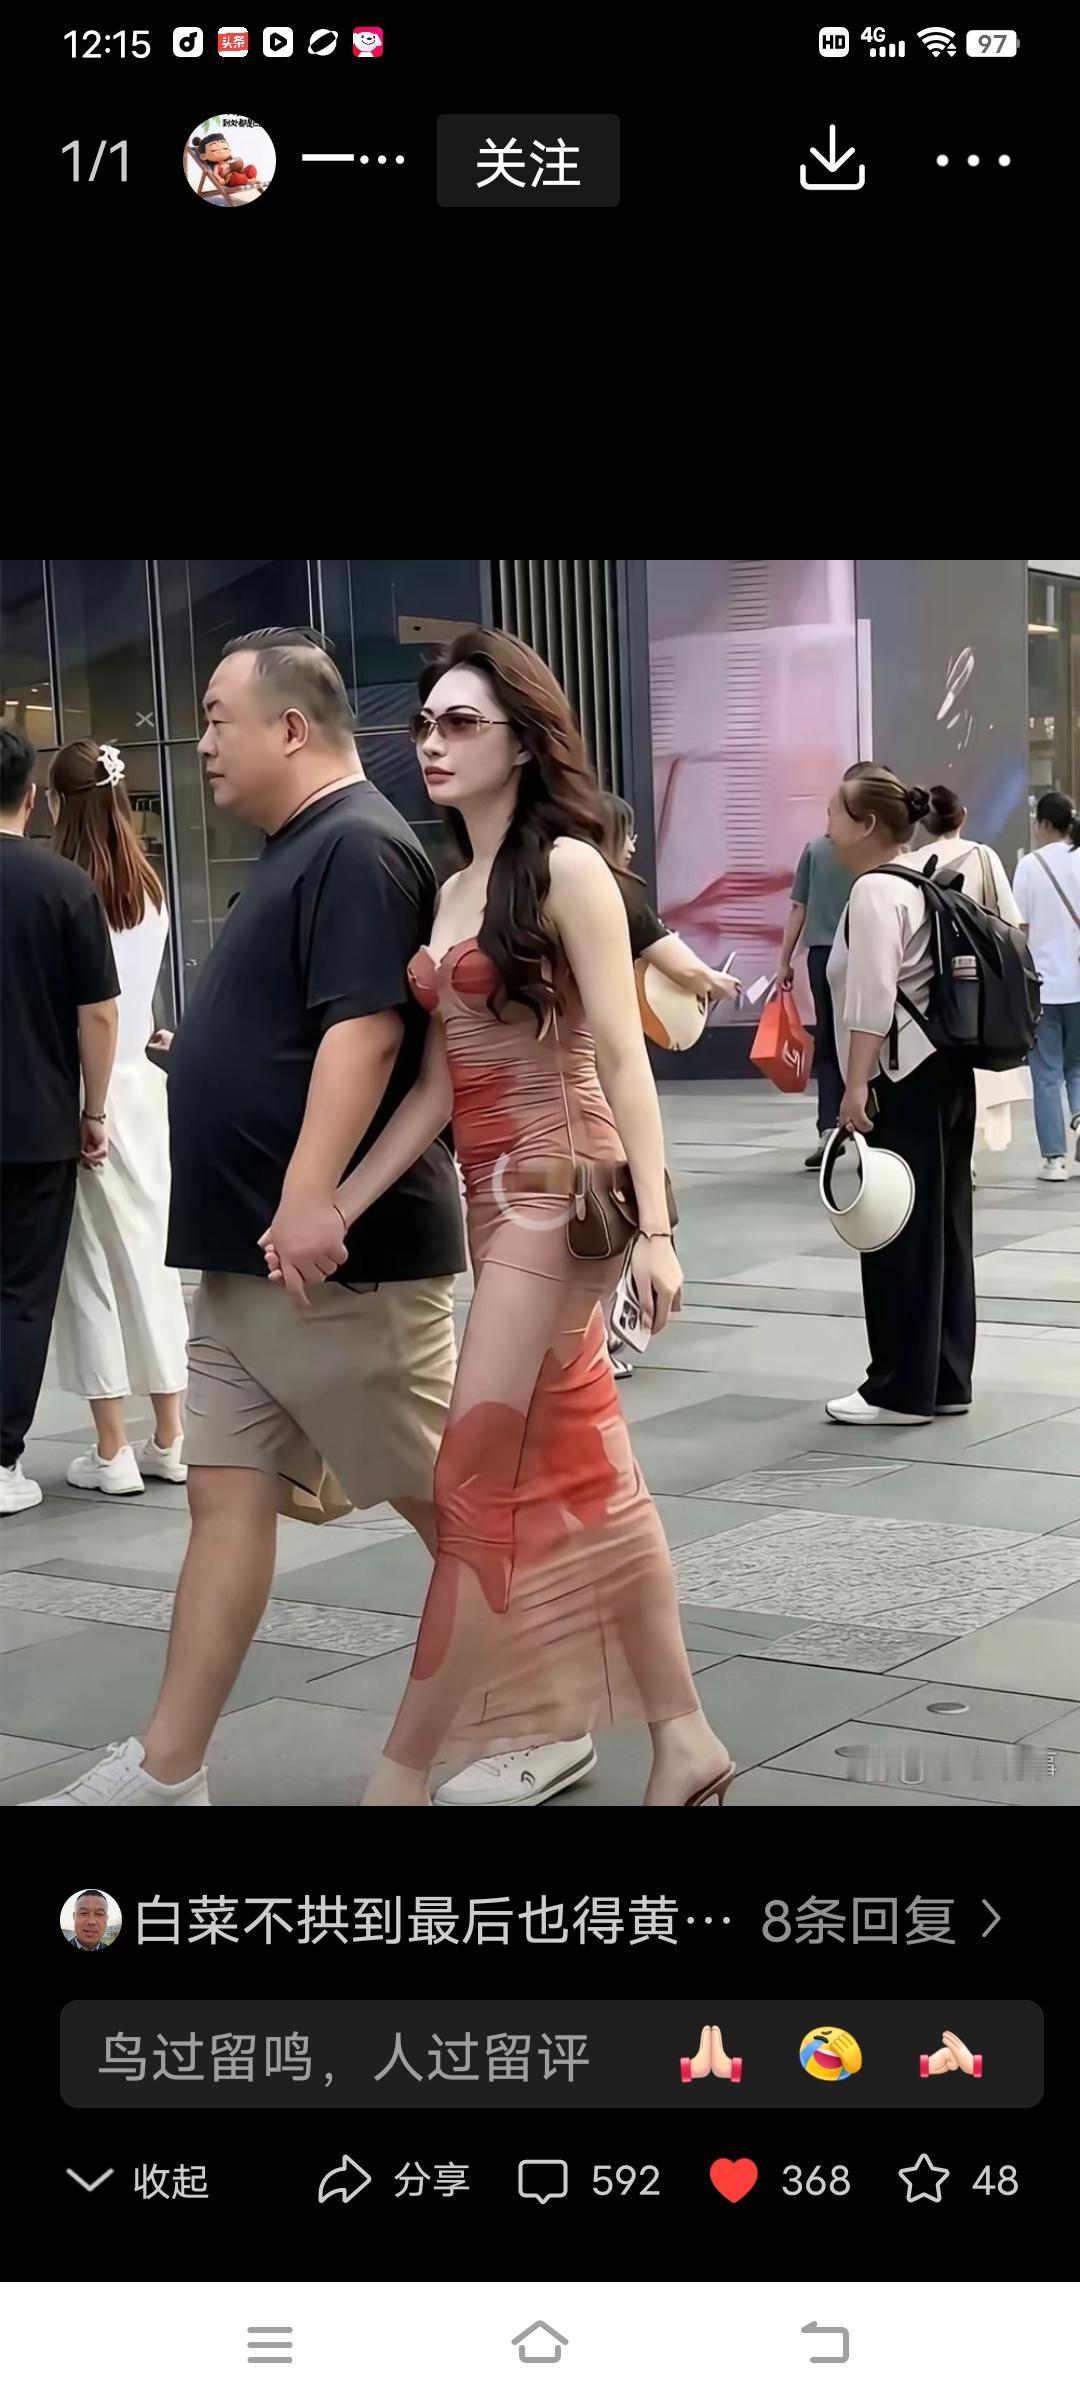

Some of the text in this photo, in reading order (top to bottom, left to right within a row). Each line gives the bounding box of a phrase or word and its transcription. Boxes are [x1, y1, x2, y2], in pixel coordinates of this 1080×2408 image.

[63, 30, 151, 59] 12:15
[221, 35, 246, 50] 头条
[822, 34, 846, 50] HD
[860, 26, 886, 43] 4G
[977, 34, 1008, 54] 97
[61, 139, 129, 183] 1/1
[475, 136, 581, 189] 关注
[761, 1894, 956, 1946] 8条回复
[98, 2030, 590, 2088] 鸟过留鸣，人过留评
[133, 2163, 210, 2200] 收起
[393, 2160, 470, 2198] 分享
[592, 2164, 661, 2197] 592
[781, 2164, 851, 2197] 368
[971, 2164, 1019, 2197] 48
